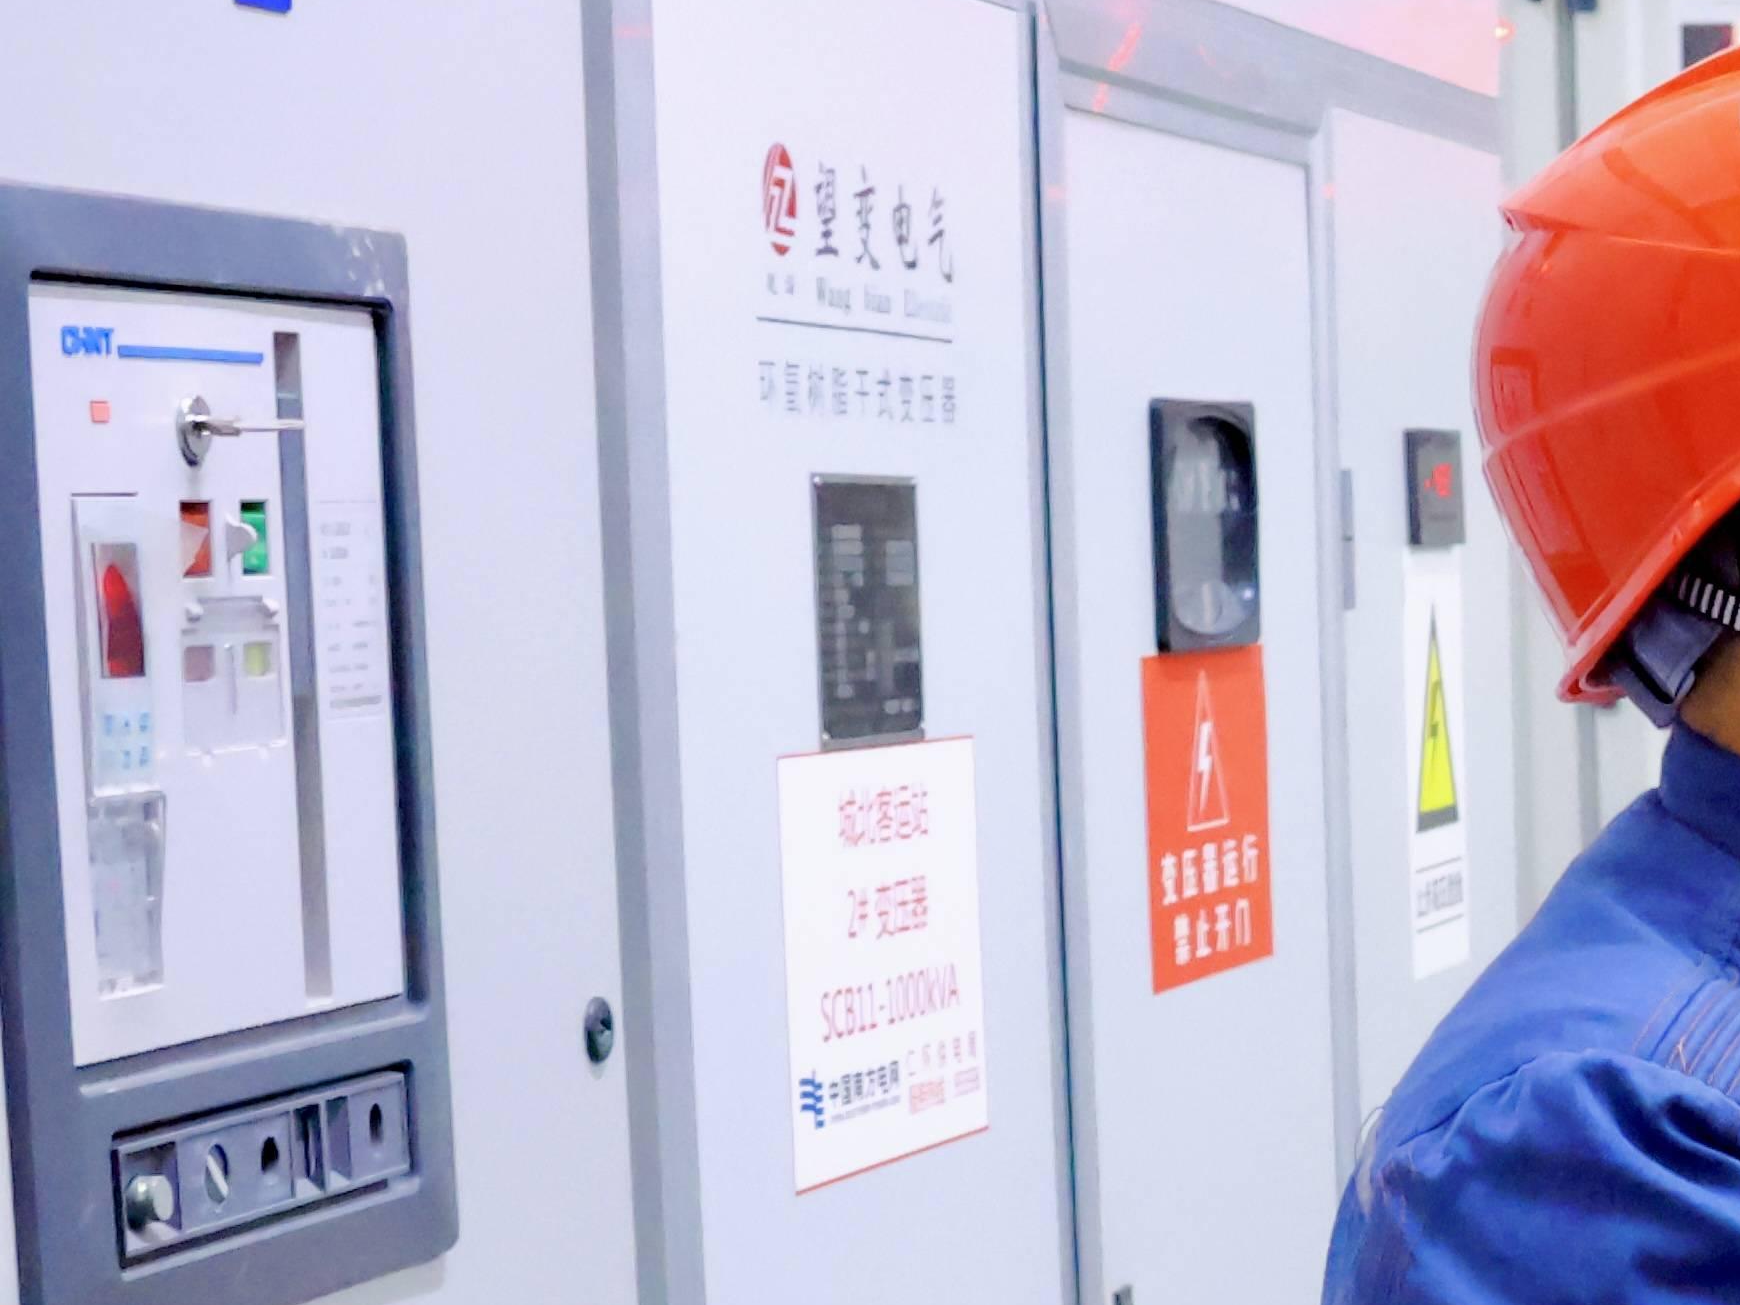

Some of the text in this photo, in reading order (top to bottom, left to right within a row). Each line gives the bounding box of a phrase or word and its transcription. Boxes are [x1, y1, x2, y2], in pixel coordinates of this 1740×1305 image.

[1161, 834, 1260, 906] 变压器运行
[1173, 898, 1252, 966] 禁止开门
